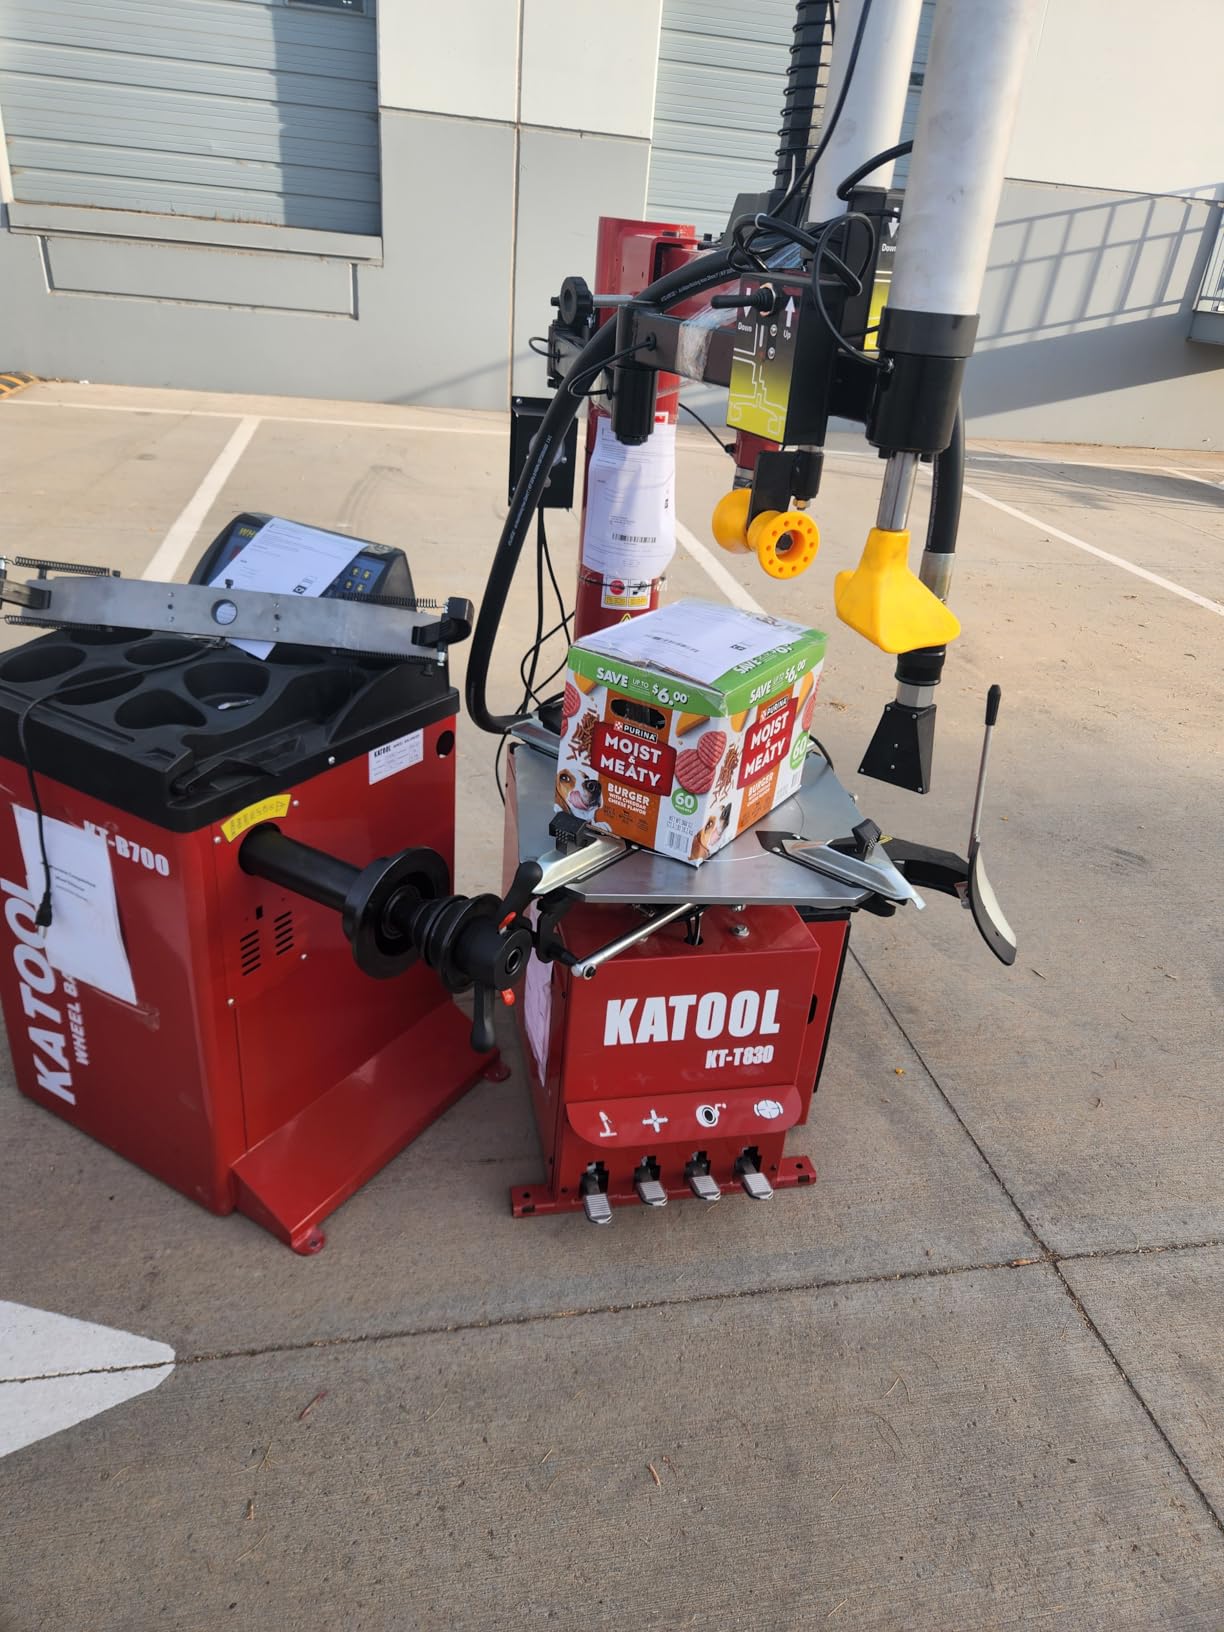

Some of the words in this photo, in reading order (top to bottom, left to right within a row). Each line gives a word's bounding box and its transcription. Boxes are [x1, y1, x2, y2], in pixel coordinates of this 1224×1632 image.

[737, 321, 753, 333] Down
[783, 329, 792, 341] Up
[596, 667, 629, 688] SAVE
[641, 680, 650, 688] TO
[749, 680, 772, 704] SAVE
[766, 697, 788, 718] PURINA
[623, 724, 656, 742] PURINA
[750, 710, 789, 750] MOIST
[604, 733, 662, 764] MOIST
[744, 737, 786, 778] MEATY
[792, 736, 807, 759] 60
[600, 754, 661, 787] MEATY
[628, 756, 636, 765] &
[607, 783, 650, 807] BURGER
[607, 798, 627, 809] CHEESE
[626, 802, 647, 815] FLAVOR
[608, 793, 622, 802] WITH
[675, 792, 695, 809] 60
[603, 988, 780, 1047] KATOOL
[67, 1001, 90, 1066] WHEEL
[705, 1044, 775, 1069] KT-T830
